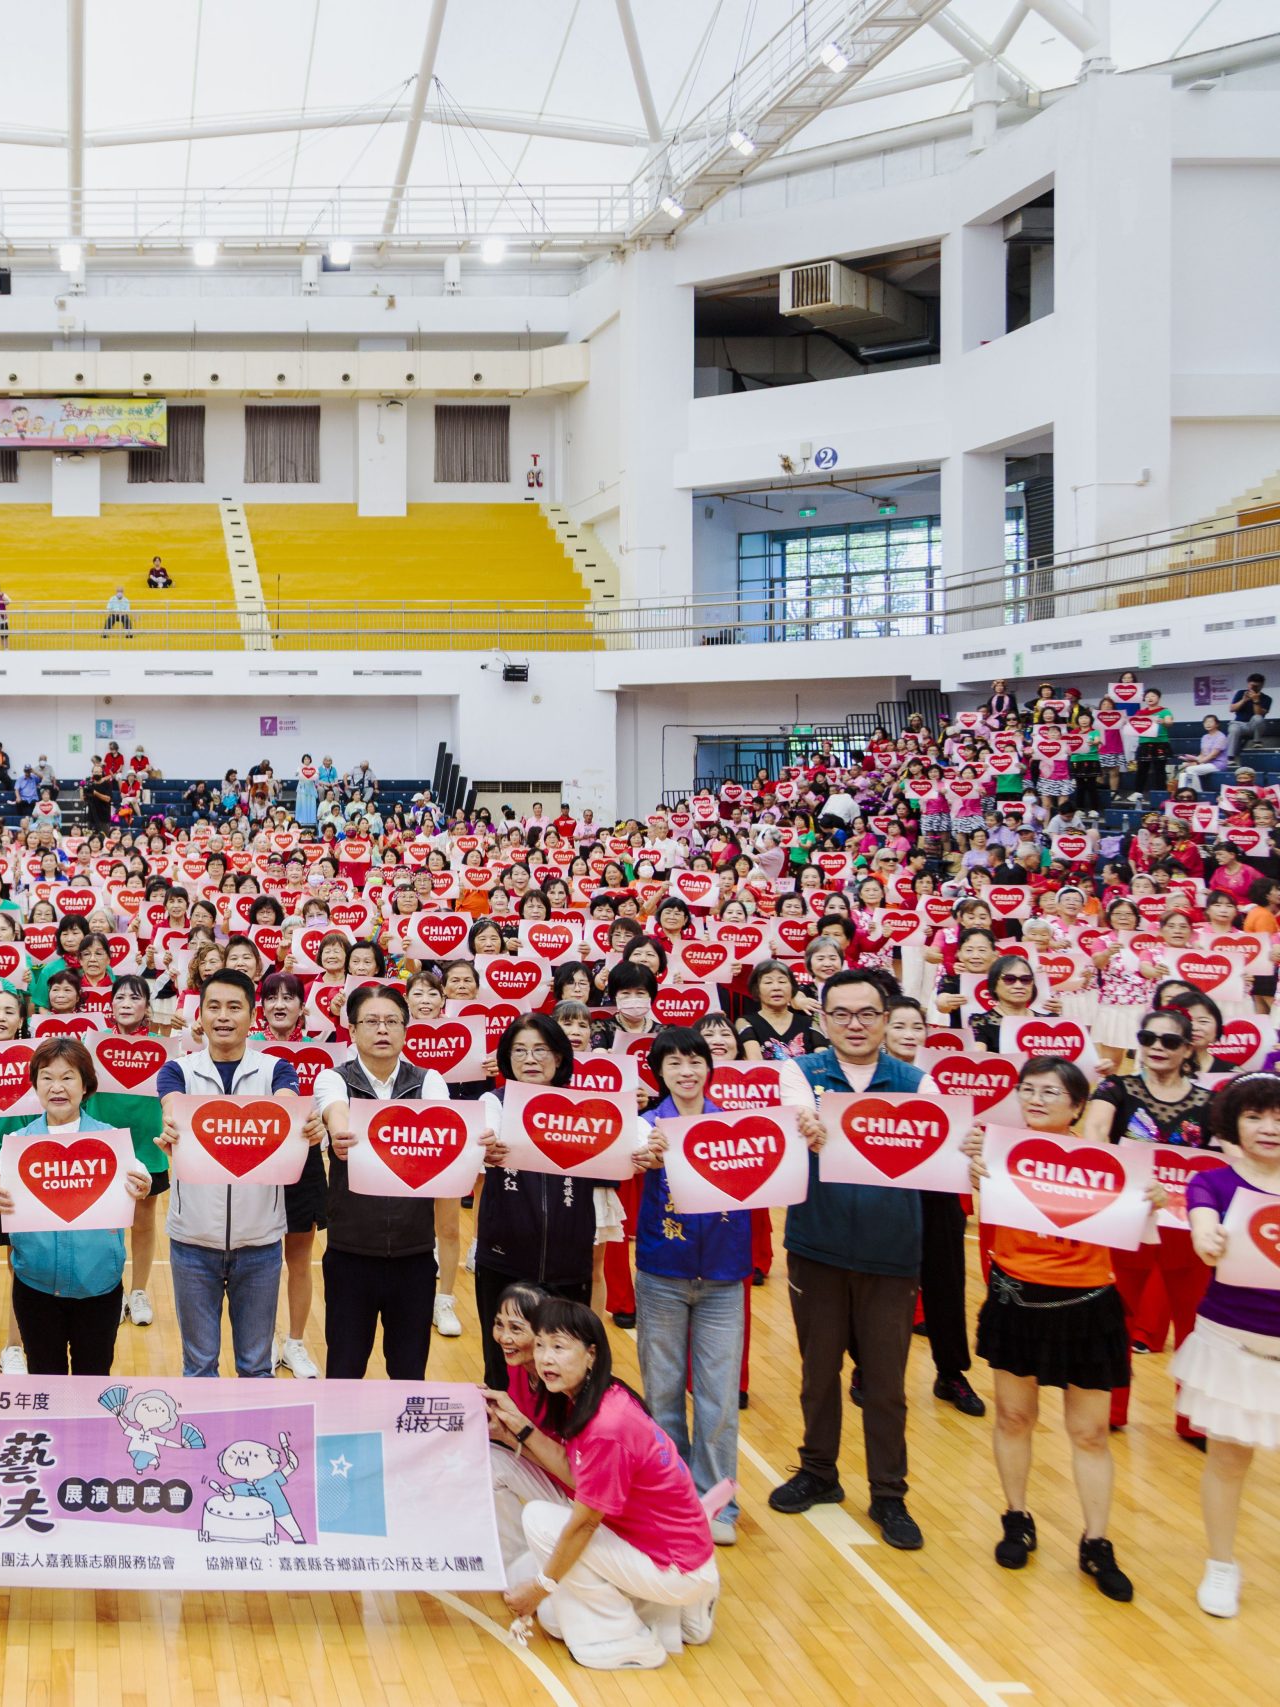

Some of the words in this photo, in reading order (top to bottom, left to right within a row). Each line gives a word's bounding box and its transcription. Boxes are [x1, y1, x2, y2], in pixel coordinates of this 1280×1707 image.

[820, 448, 834, 468] 2
[1198, 681, 1206, 696] 5
[100, 722, 107, 732] 8
[264, 719, 272, 730] 7
[680, 880, 710, 888] CHIAYI
[333, 911, 364, 920] CHIAYI
[422, 926, 462, 935] CHIAYI
[782, 928, 807, 936] CHIA
[25, 935, 55, 943] CHIAY
[259, 936, 282, 944] CHIA
[532, 933, 569, 943] CHIAYI
[722, 934, 758, 942] CHIAYI
[1132, 941, 1164, 949] CHIA
[1214, 944, 1258, 954] CHIAYI
[686, 951, 723, 960] CHIAYI
[1180, 963, 1228, 974] CHIAYI
[491, 971, 536, 981] CHIAYI
[656, 1000, 704, 1010] CHIAYI
[407, 1037, 464, 1050] CHIAYI
[1022, 1036, 1080, 1047] CHIAYI
[104, 1049, 159, 1061] CHIAYI
[938, 1071, 1009, 1087] CHIAYI
[710, 1084, 779, 1099] CHIAYI
[948, 1086, 996, 1097] COUNTY
[202, 1119, 279, 1134] CHIAYI
[533, 1113, 612, 1134] CHIAYI
[851, 1117, 938, 1137] CHIAYI
[215, 1136, 265, 1145] COUNTY
[378, 1126, 456, 1145] CHIAYI
[544, 1132, 596, 1144] COUNTY
[694, 1136, 776, 1159] CHIAYI
[865, 1136, 922, 1148] COUNTY
[390, 1146, 442, 1156] COUNTY
[29, 1159, 106, 1178] CHIAYI
[710, 1157, 763, 1170] COUNTY
[1016, 1158, 1116, 1191] CHIAYI
[43, 1178, 93, 1189] COUNTY
[1031, 1180, 1094, 1201] COUNTY
[64, 1484, 188, 1506] 展演觀摩會
